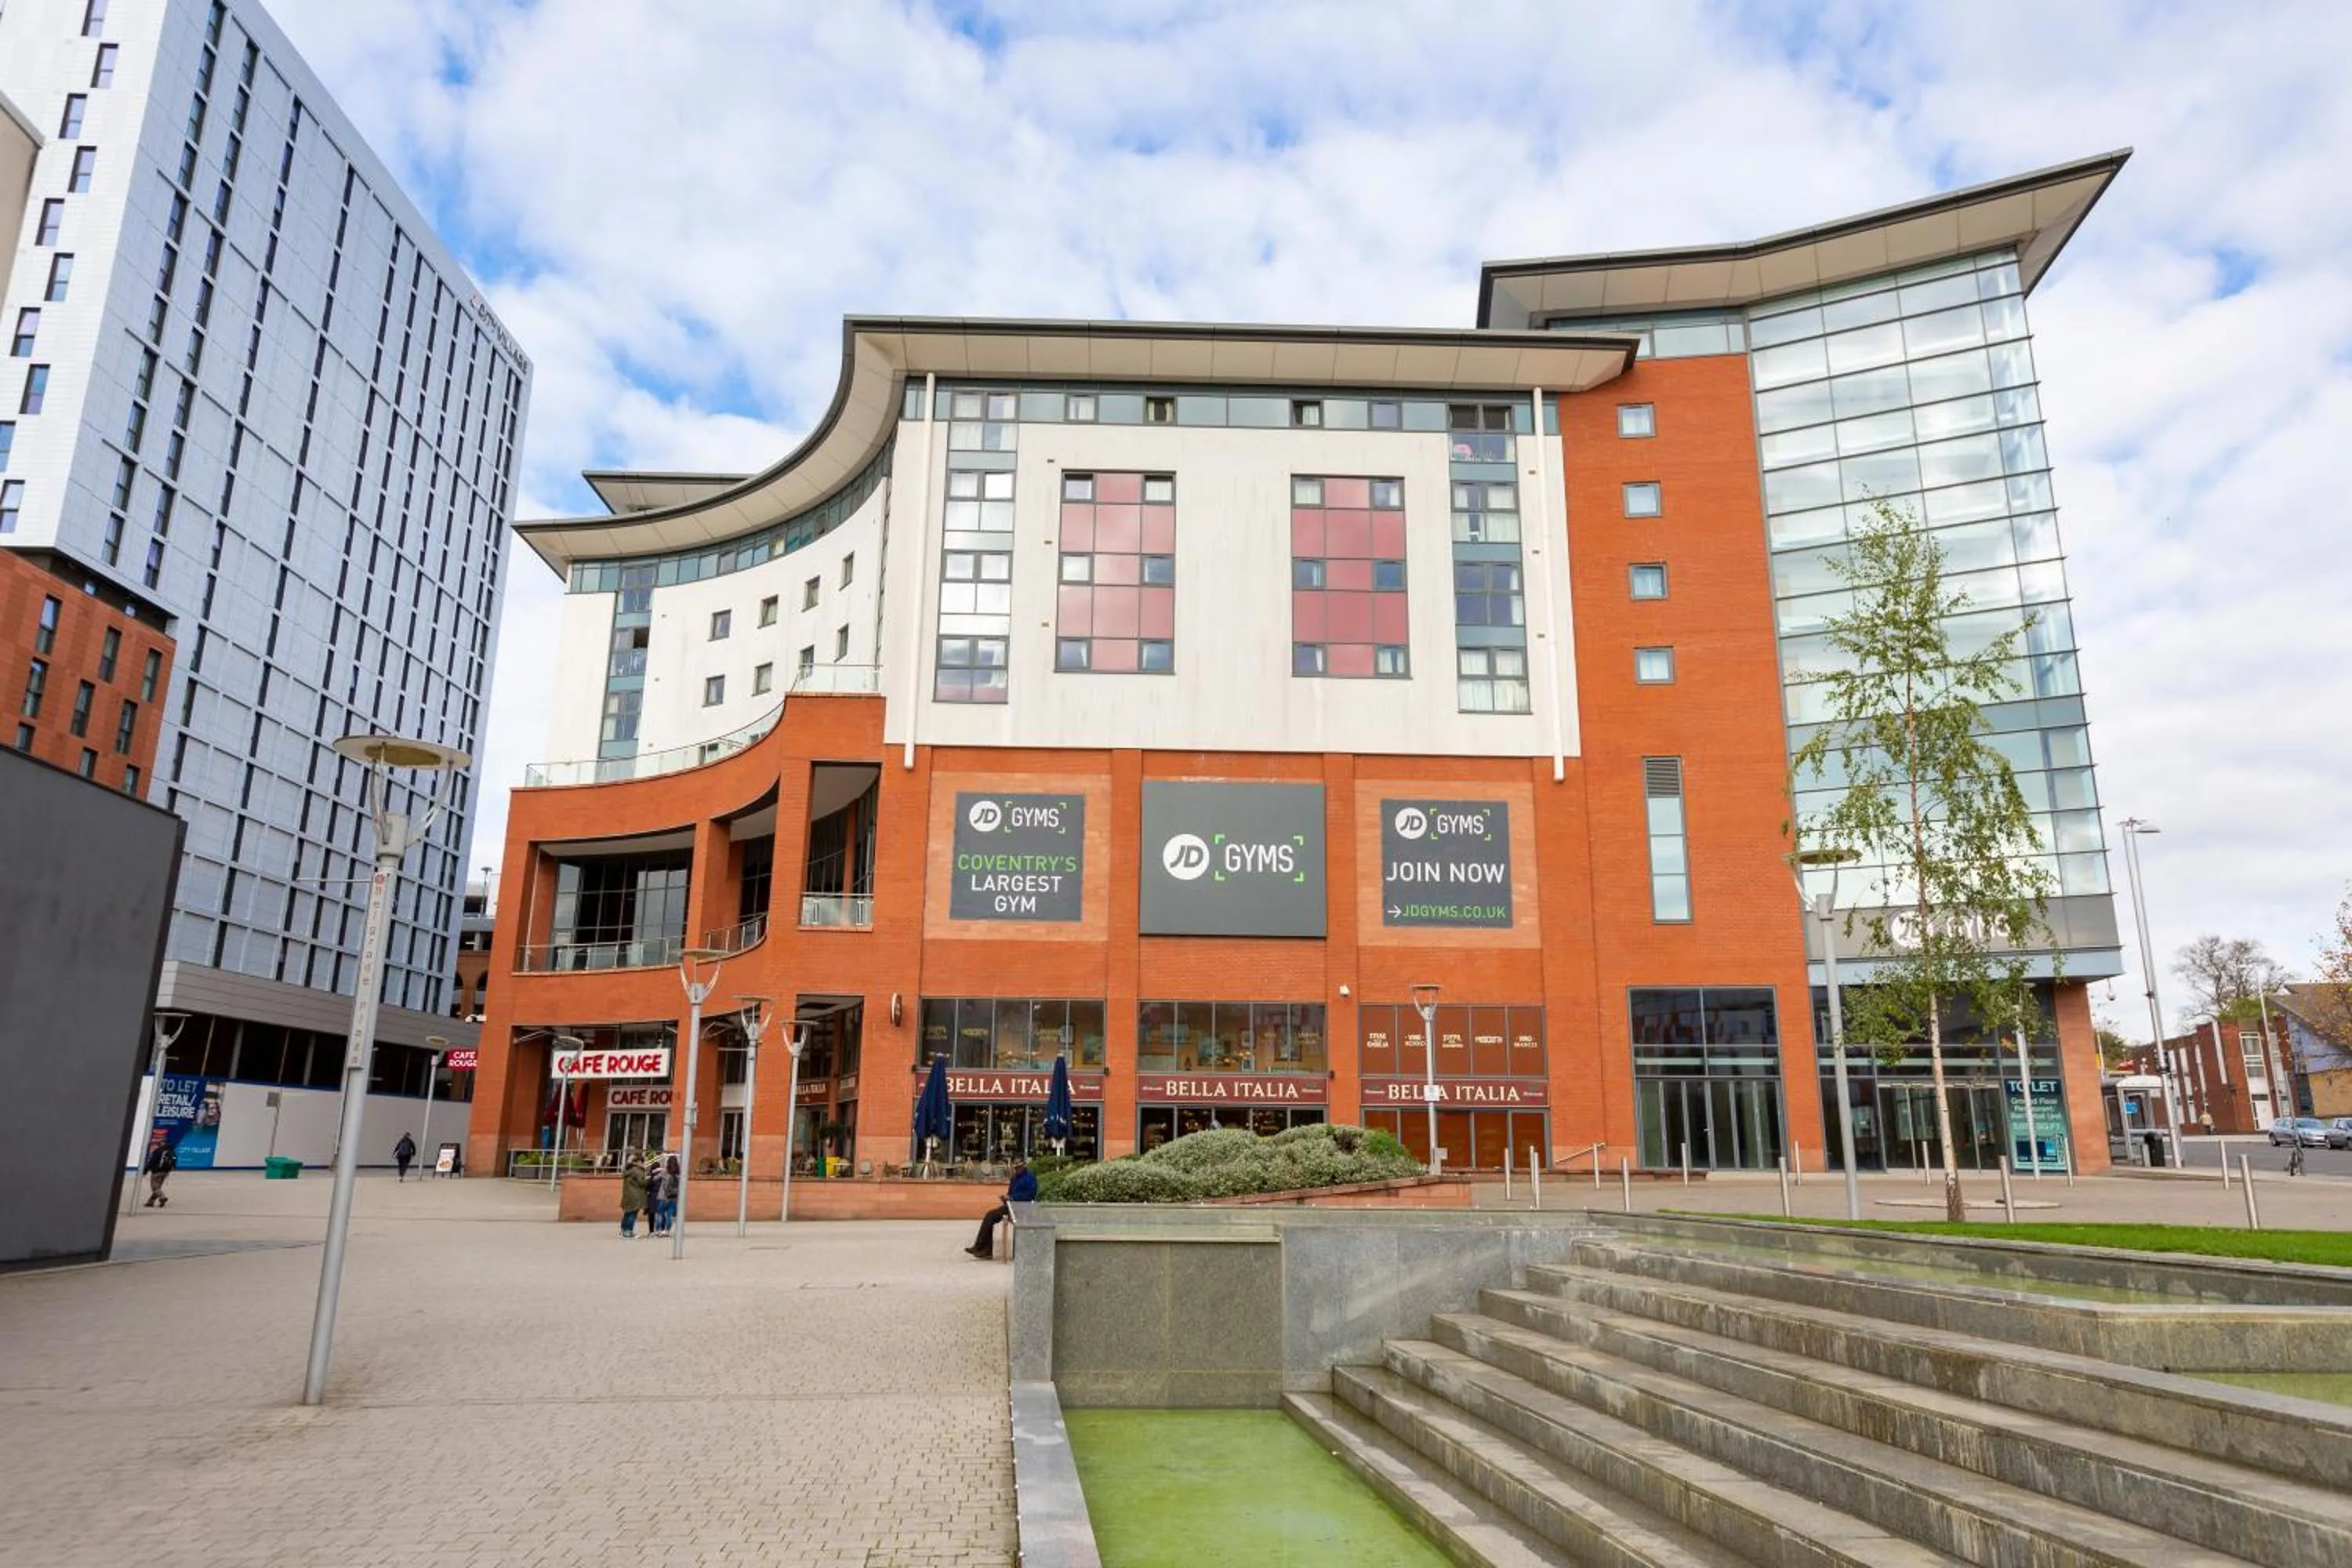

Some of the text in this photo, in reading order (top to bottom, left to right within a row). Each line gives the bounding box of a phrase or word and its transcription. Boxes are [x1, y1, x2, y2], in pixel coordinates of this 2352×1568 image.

[1011, 807, 1060, 828] GYMS
[1436, 814, 1485, 835] GYMS
[957, 854, 1077, 873] COVENTRY'S
[1225, 843, 1294, 873] GYMS
[1385, 862, 1505, 884] JOIN NOW
[971, 874, 1063, 892] LARGEST
[994, 895, 1036, 913] GYM
[1403, 904, 1506, 919] JDGYMS.CO.UK
[607, 1054, 662, 1073] ROUGE
[177, 1080, 199, 1094] LET
[946, 1076, 1076, 1095] BELLA ITALA
[1165, 1080, 1300, 1099] BELLA ITALIA
[1388, 1084, 1521, 1102] BELA ITALIA
[2031, 1081, 2058, 1092] LET
[156, 1105, 196, 1119] LEISURE
